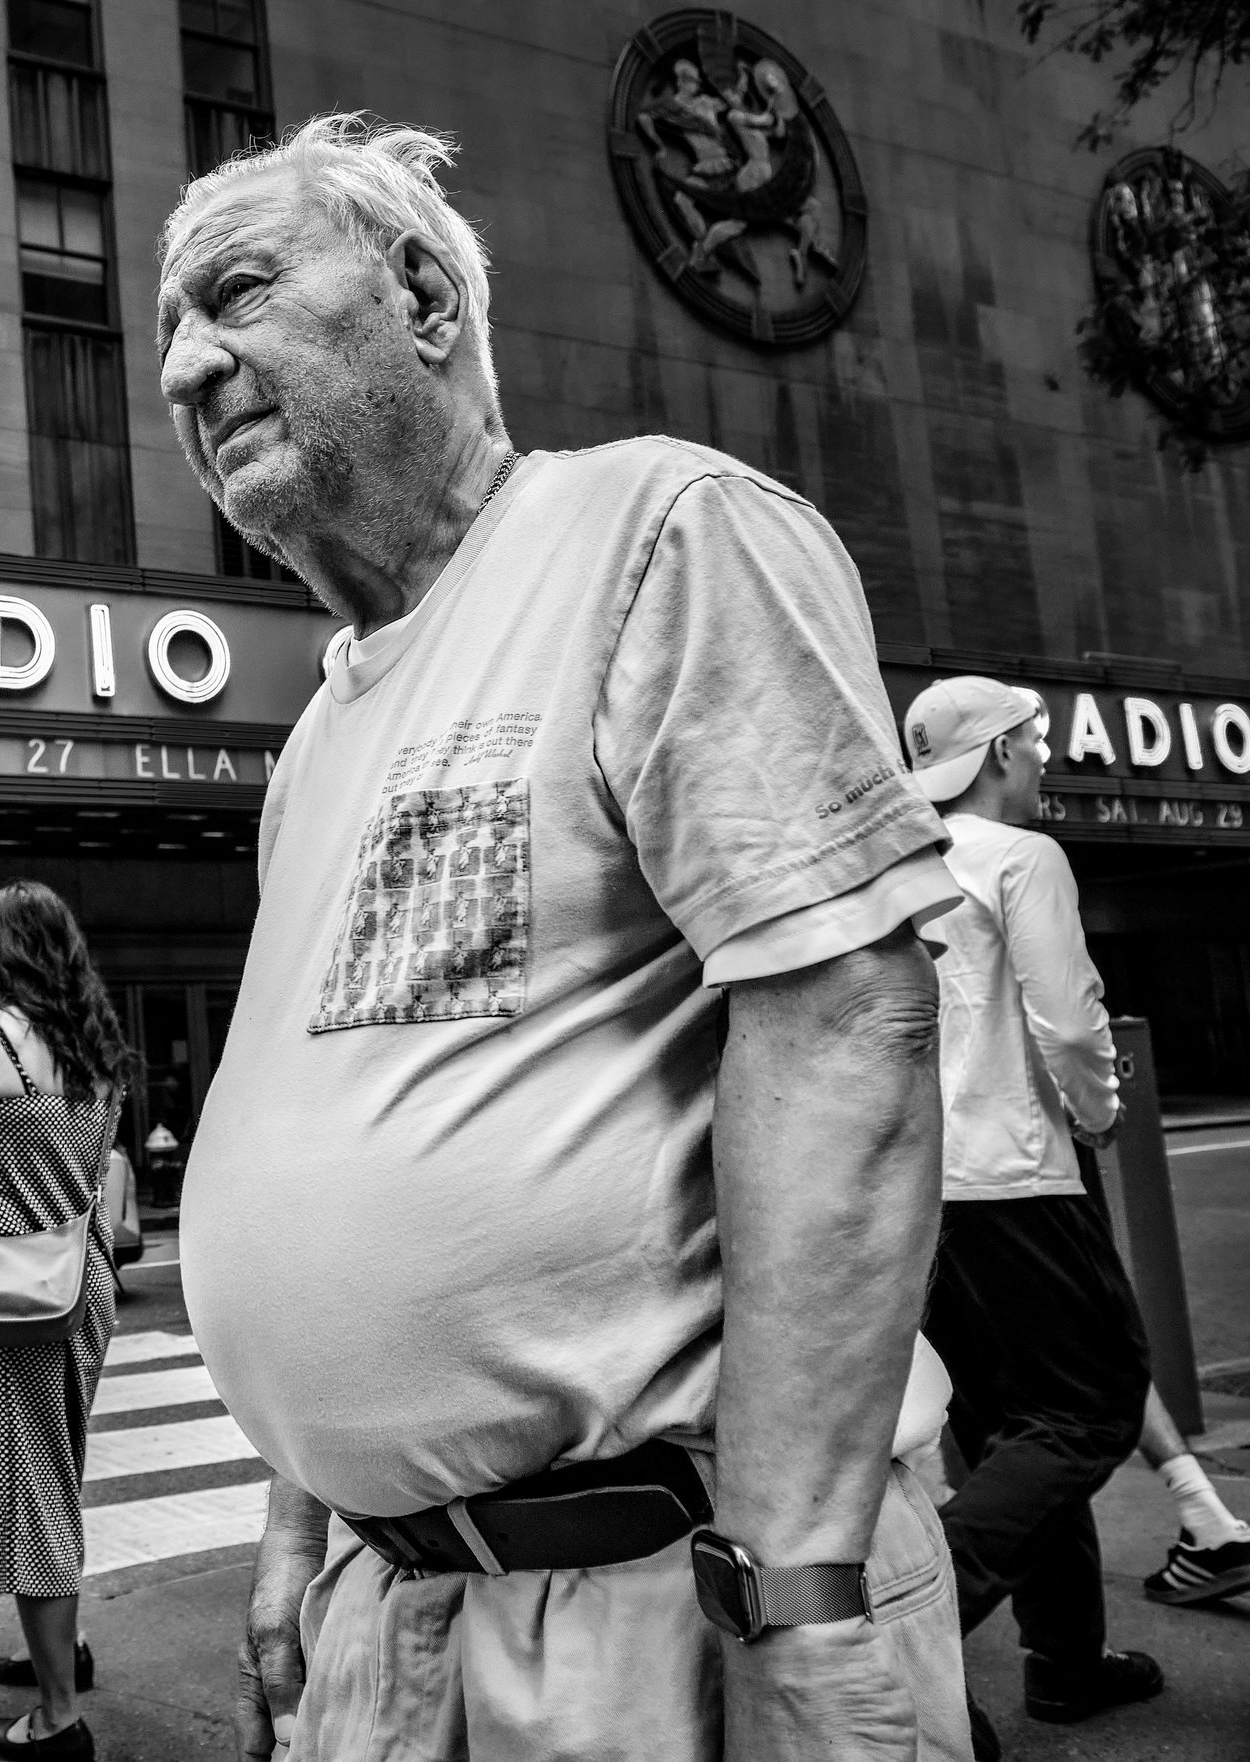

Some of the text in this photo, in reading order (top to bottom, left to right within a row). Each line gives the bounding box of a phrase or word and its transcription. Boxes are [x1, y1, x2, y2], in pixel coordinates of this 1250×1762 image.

[496, 724, 538, 737] fantasy
[1068, 692, 1250, 774] ADIO
[26, 739, 75, 775] 27
[135, 743, 238, 782] ELLA
[815, 802, 842, 819] So
[845, 763, 896, 804] much
[1158, 800, 1204, 828] AUG
